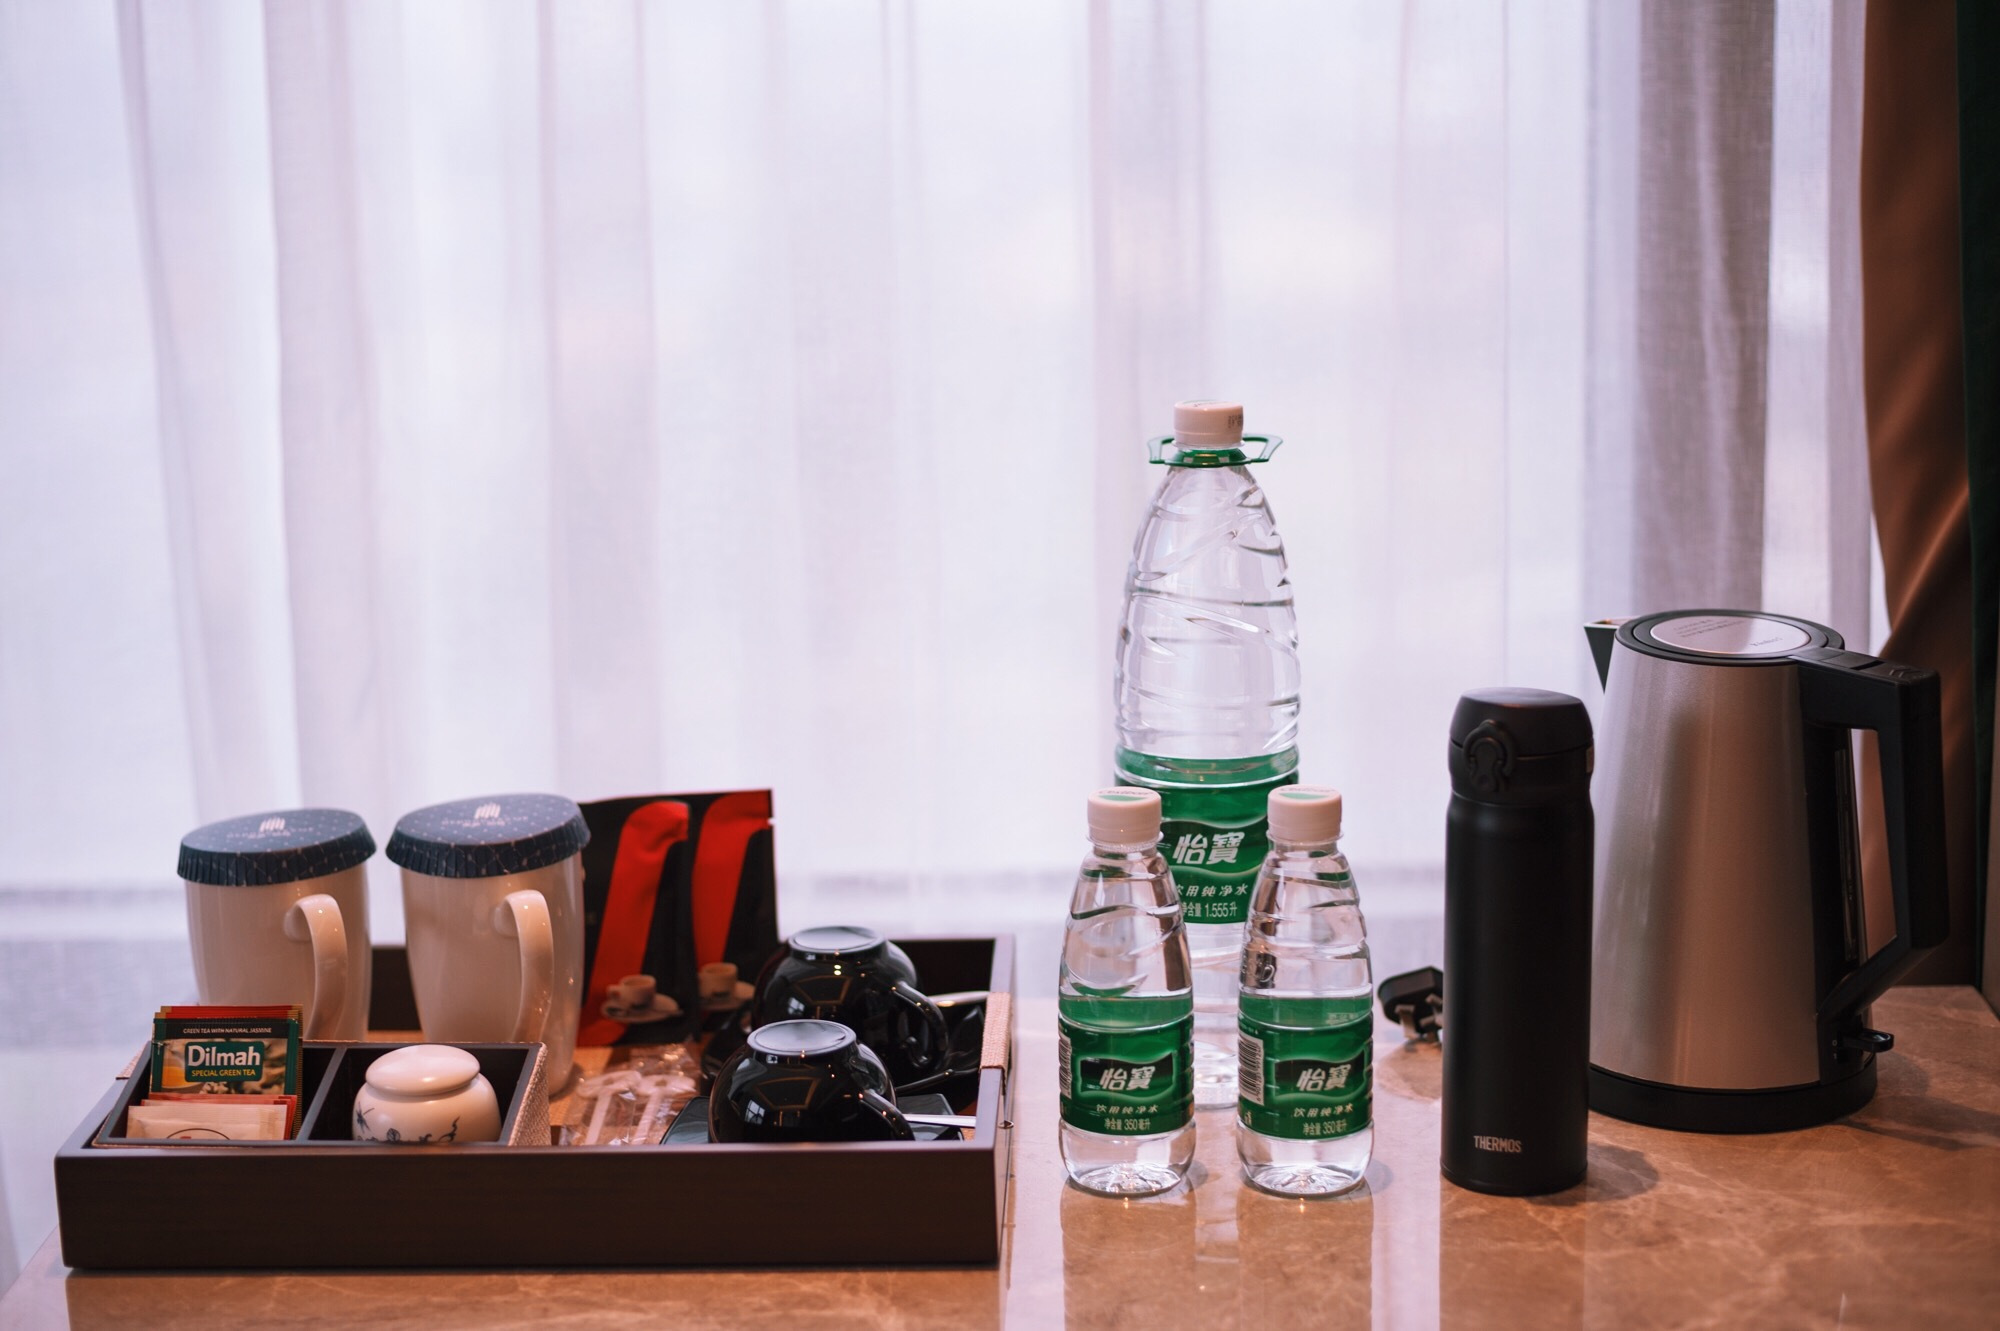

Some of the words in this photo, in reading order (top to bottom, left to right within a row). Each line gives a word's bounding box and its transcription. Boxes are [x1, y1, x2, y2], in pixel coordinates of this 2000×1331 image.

[1172, 831, 1245, 865] 怡寶
[187, 1045, 261, 1067] Dilmah
[191, 1069, 218, 1077] SPECIAL
[219, 1069, 242, 1077] GREEN
[1099, 1065, 1156, 1091] 怡寶
[1296, 1063, 1352, 1092] 怡寶
[1473, 1135, 1522, 1153] THERMOS
